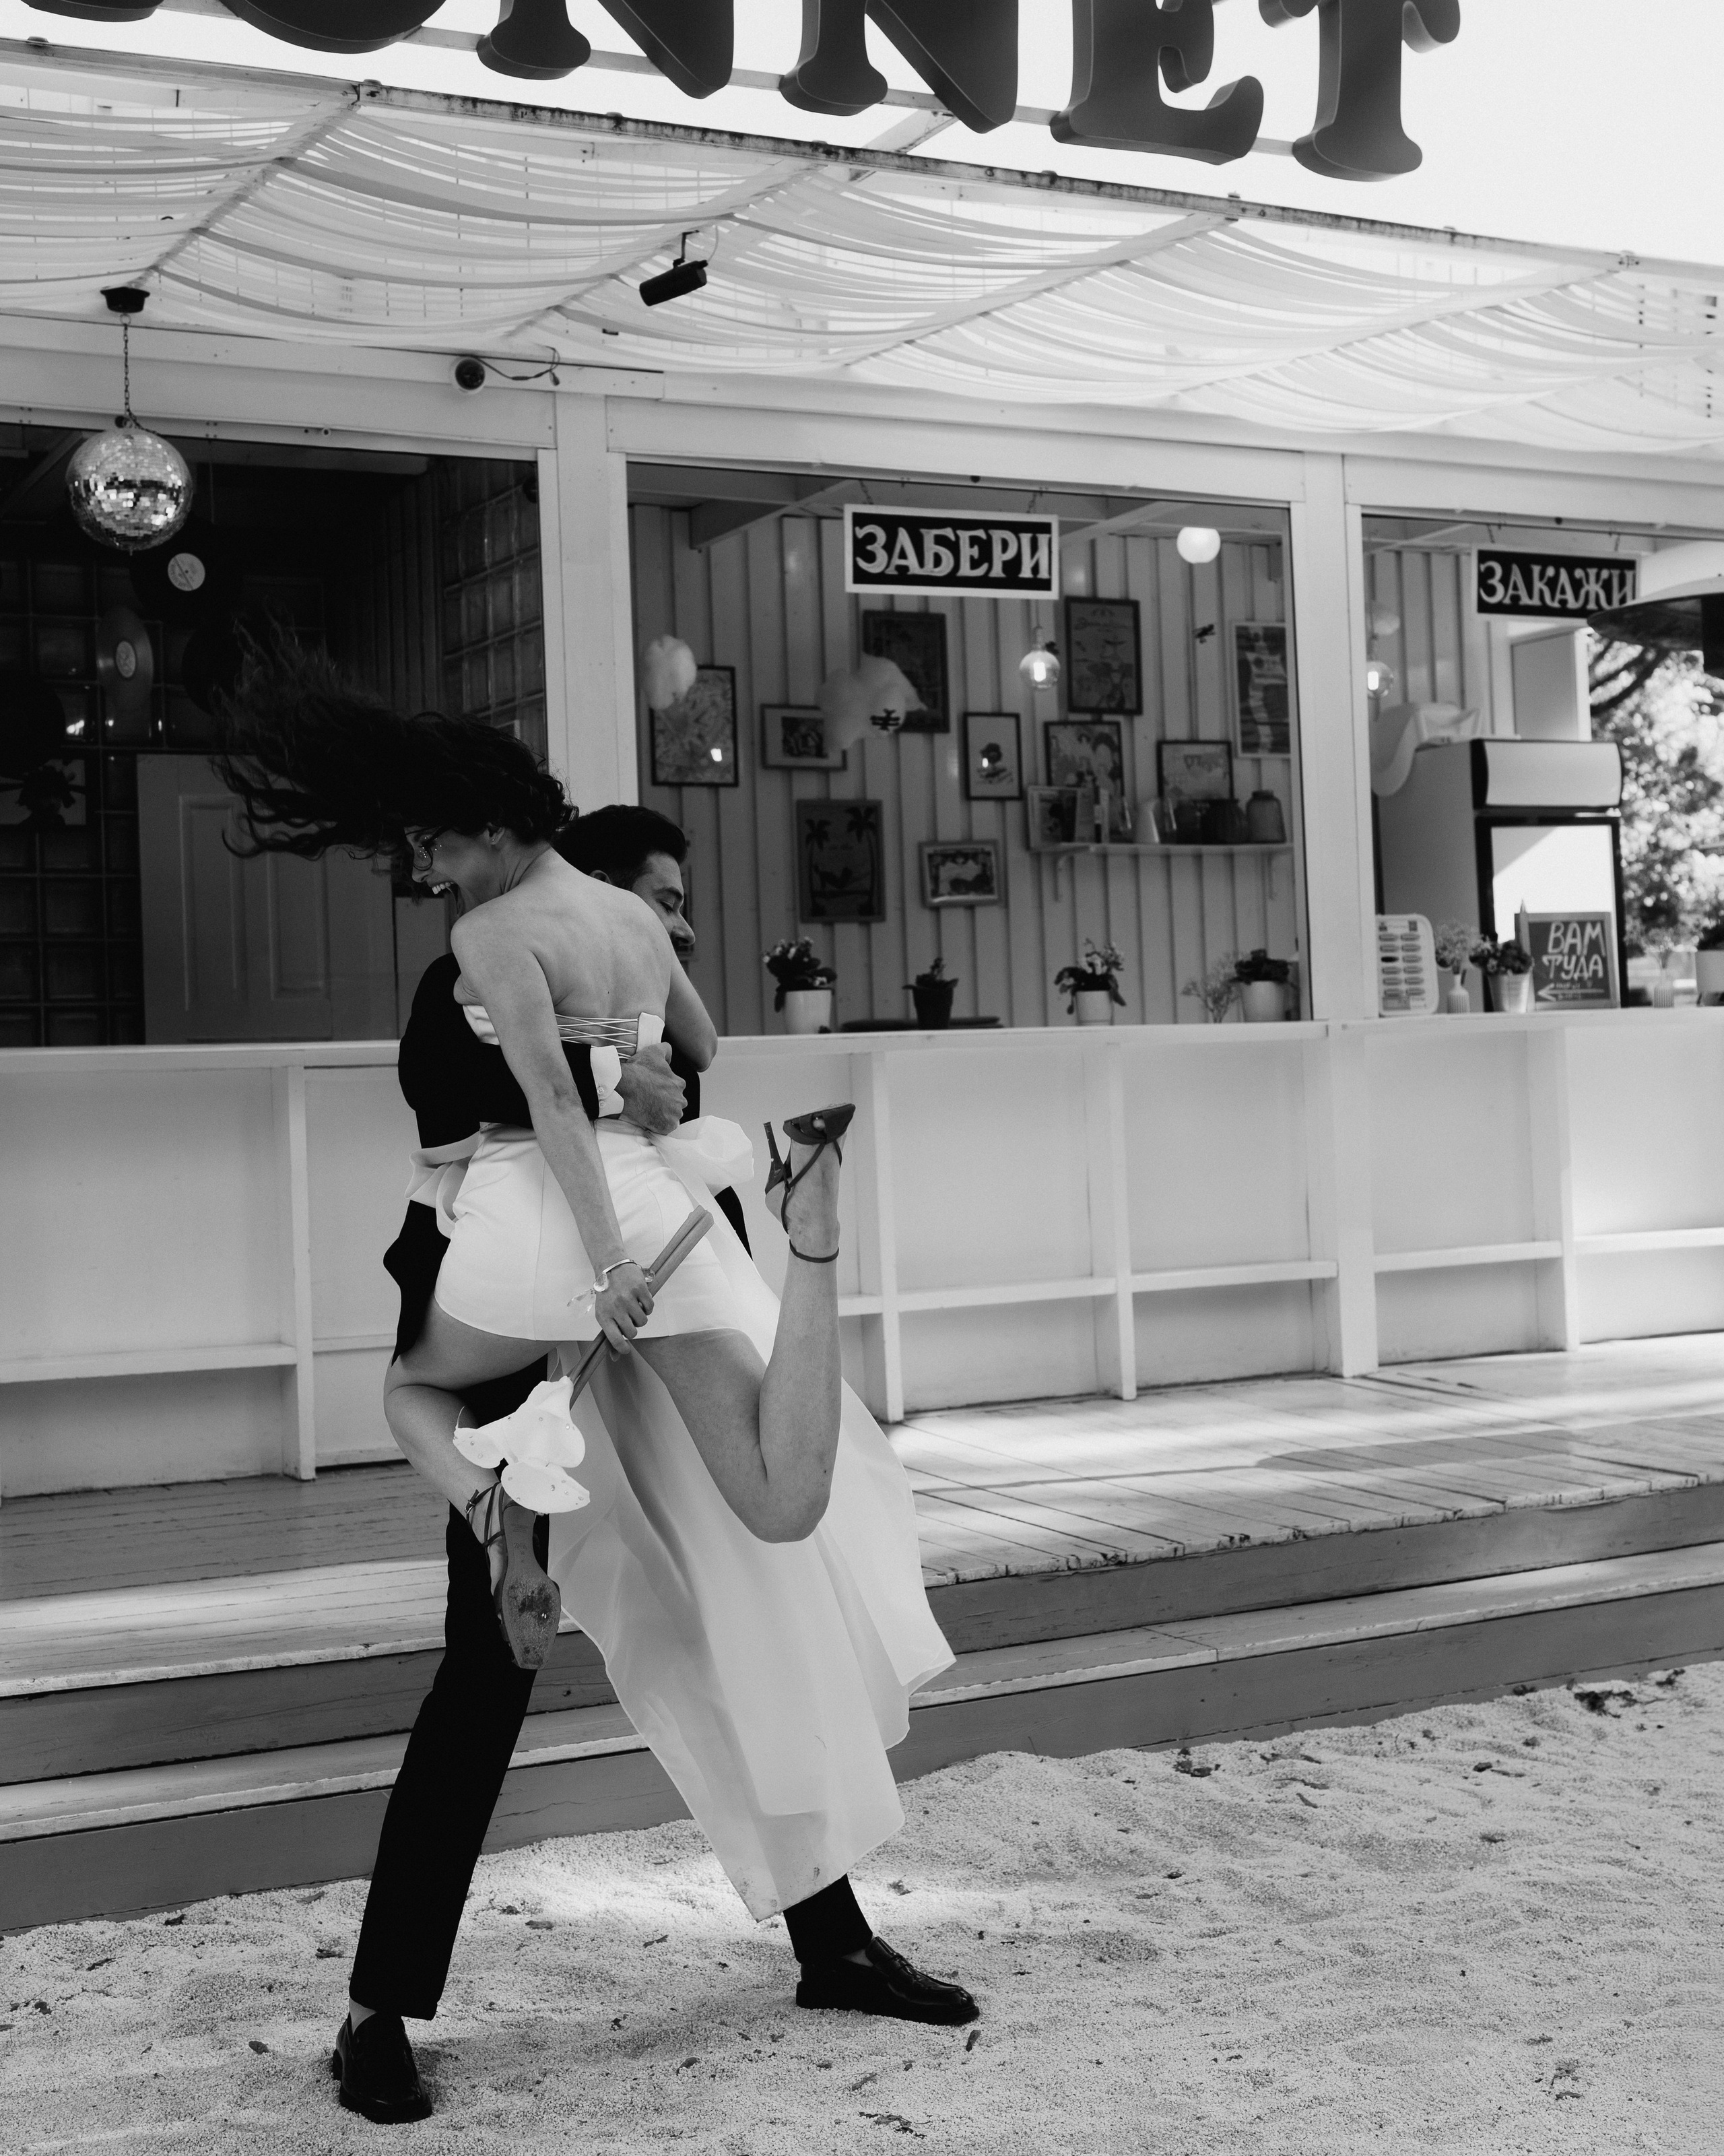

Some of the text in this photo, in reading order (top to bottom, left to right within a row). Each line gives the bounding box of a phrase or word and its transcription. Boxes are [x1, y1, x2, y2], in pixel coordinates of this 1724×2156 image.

[855, 524, 1051, 579] ЗАБЕРИ
[1479, 560, 1636, 610] ЗАКАЖИ
[1547, 921, 1606, 957] ВАМ
[1541, 954, 1604, 981] ТУДА
